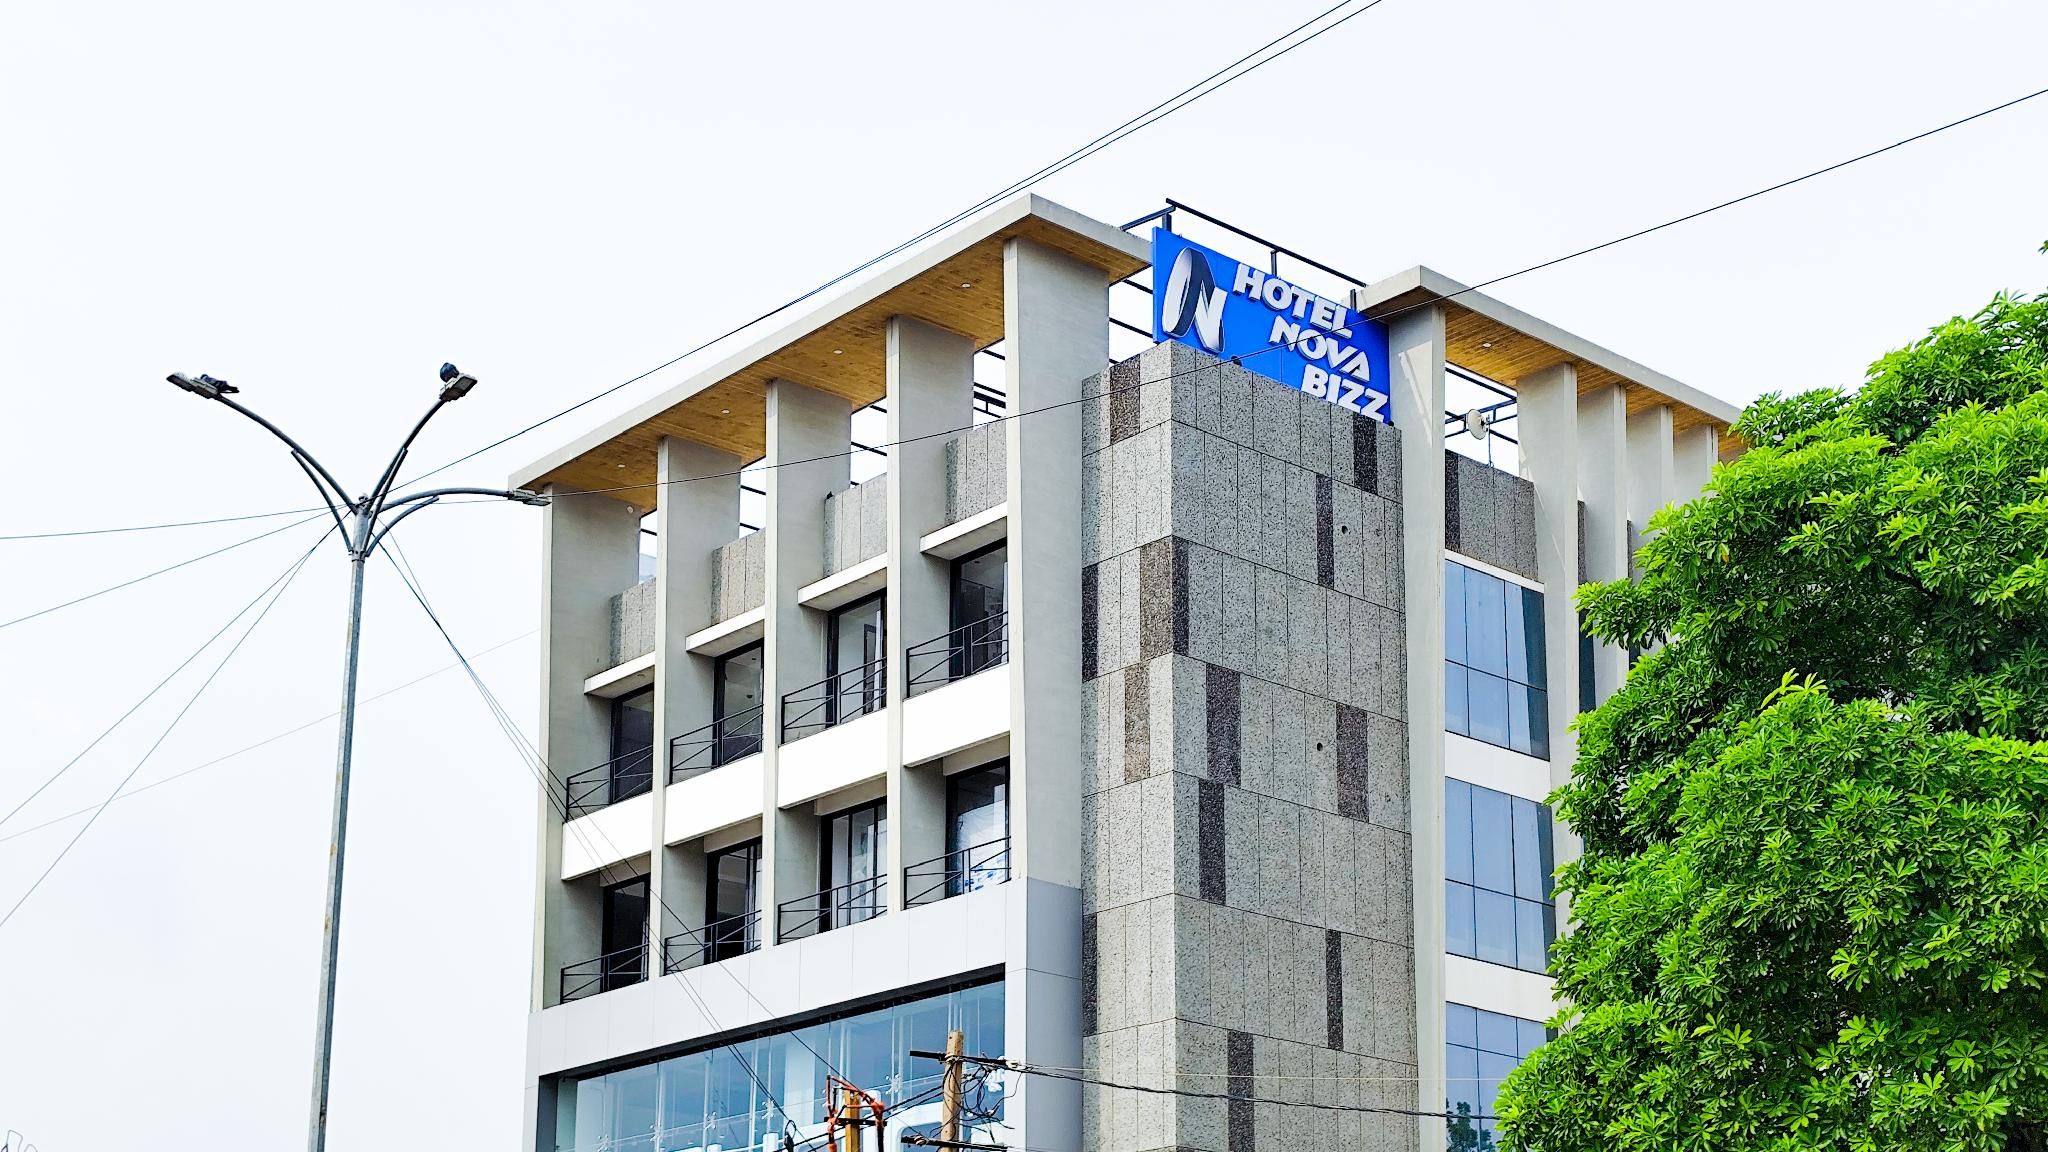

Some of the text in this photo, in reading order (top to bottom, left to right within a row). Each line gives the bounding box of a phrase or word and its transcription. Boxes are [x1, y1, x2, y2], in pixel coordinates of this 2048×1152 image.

[1233, 264, 1353, 339] HOTEL
[1269, 315, 1370, 381] NOVA
[1303, 364, 1389, 422] BIZZ
